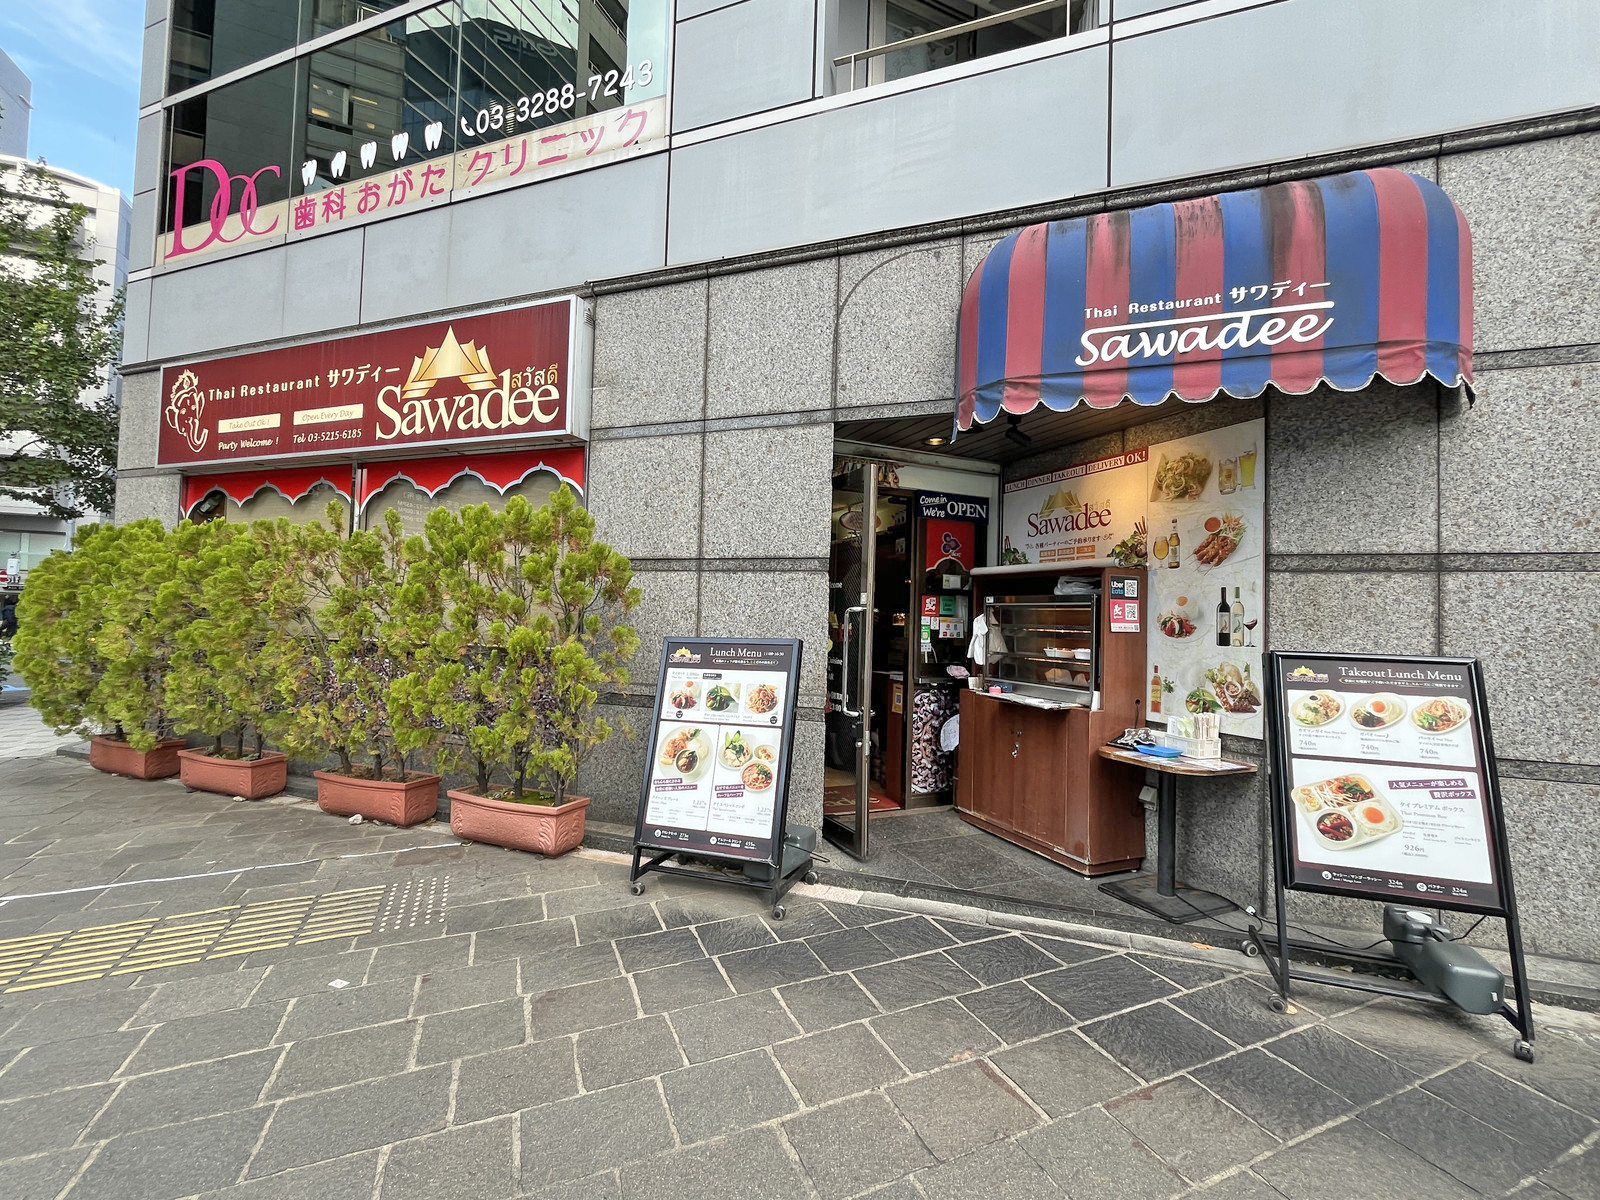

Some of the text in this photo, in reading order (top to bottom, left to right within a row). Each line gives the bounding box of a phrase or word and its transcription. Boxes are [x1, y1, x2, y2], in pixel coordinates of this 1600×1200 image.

[476, 59, 654, 135] 03-3288-7243
[1084, 279, 1332, 319] Thai Restaurant サワディー
[1074, 301, 1335, 367] Sawadee
[208, 361, 401, 402] Thai Restaurant サワディー
[511, 362, 558, 389] สวัสดี
[375, 368, 560, 441] Sawadee
[228, 421, 244, 430] Take
[244, 420, 257, 429] Out
[302, 409, 354, 424] Open Every Day
[218, 441, 238, 452] Party
[240, 437, 273, 449] Welcome
[293, 428, 362, 444] Tel 03-5215-6185
[1006, 450, 1147, 492] LUNCH DINNER TAKEOUT DELIVERY OK!
[919, 495, 940, 505] Come
[922, 501, 988, 519] We're OPEN
[1027, 503, 1112, 538] Sawadee
[709, 647, 735, 657] Lunch
[737, 648, 762, 658] Menu
[1338, 666, 1463, 682] Takeout Lunch Menu
[1392, 780, 1464, 789] 人気メニューが楽しめる
